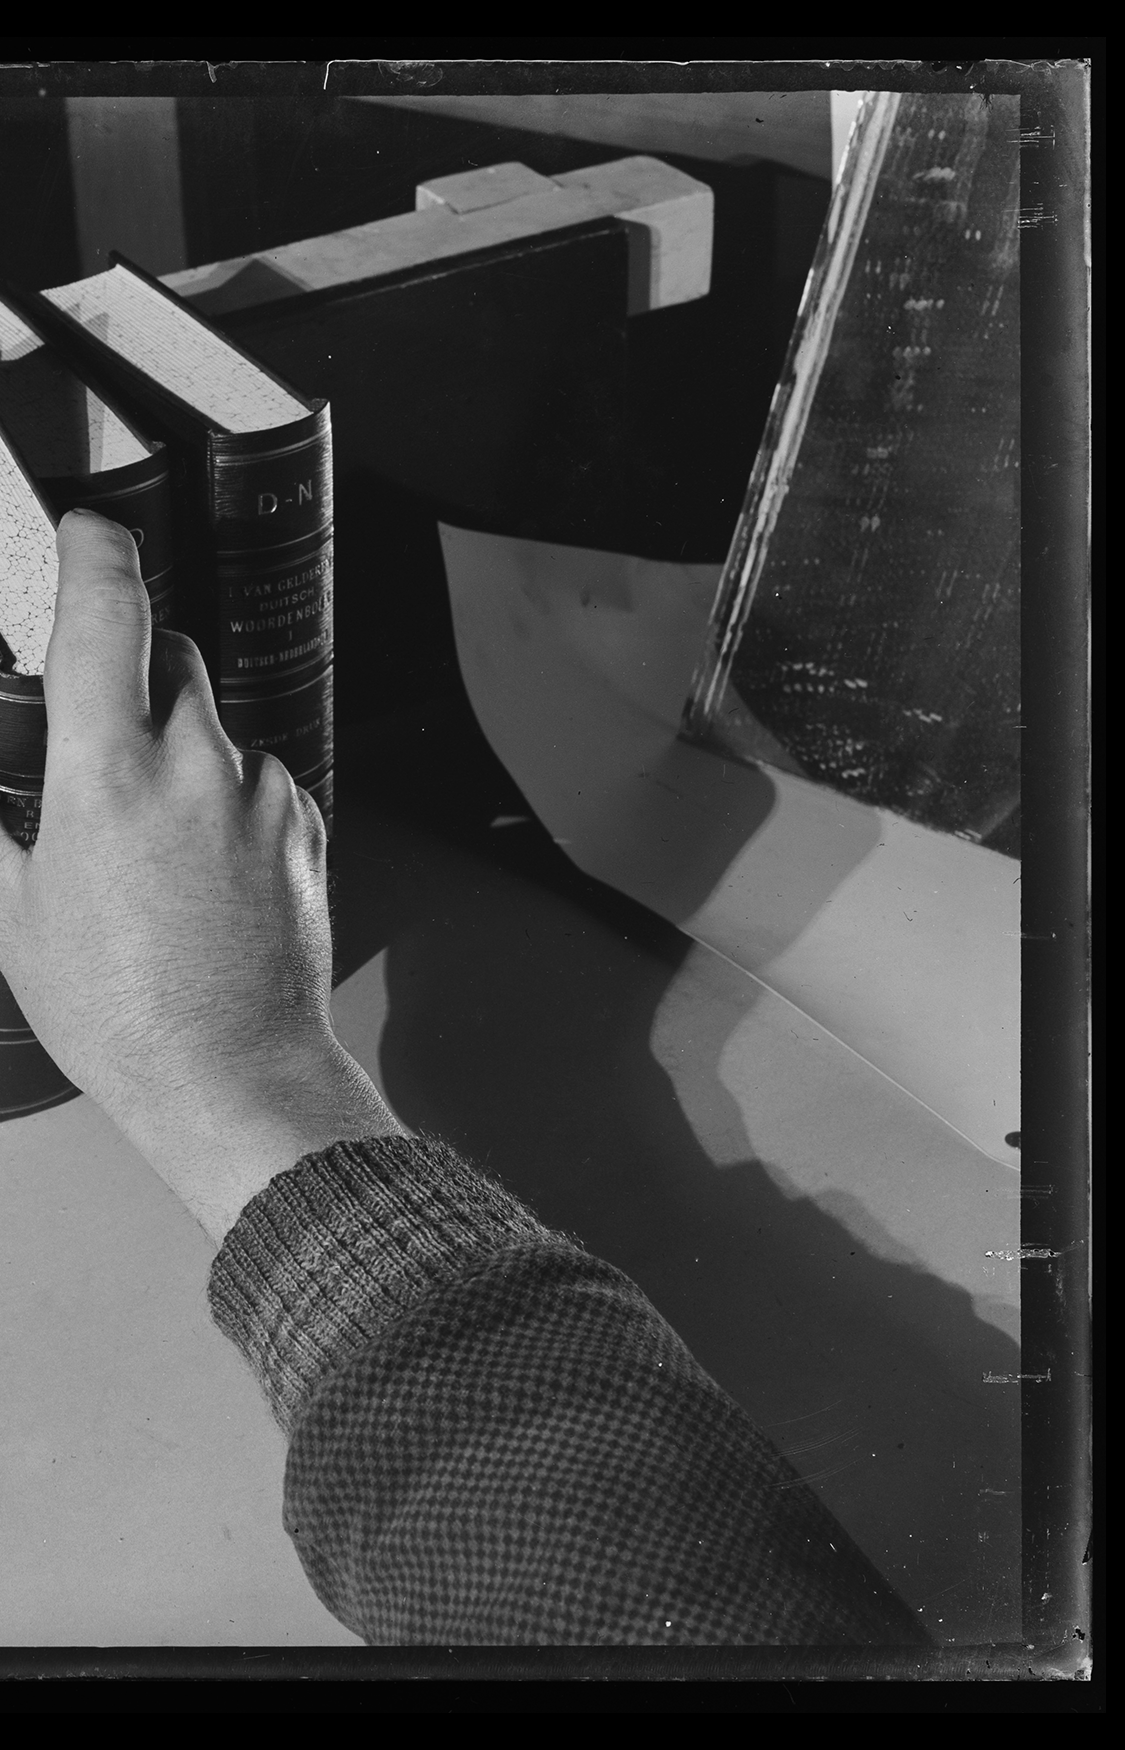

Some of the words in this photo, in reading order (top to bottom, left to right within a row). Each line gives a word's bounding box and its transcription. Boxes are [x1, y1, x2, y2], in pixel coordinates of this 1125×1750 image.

[257, 479, 313, 516] D-N
[242, 583, 272, 597] VAN
[259, 586, 315, 612] DUITSCH
